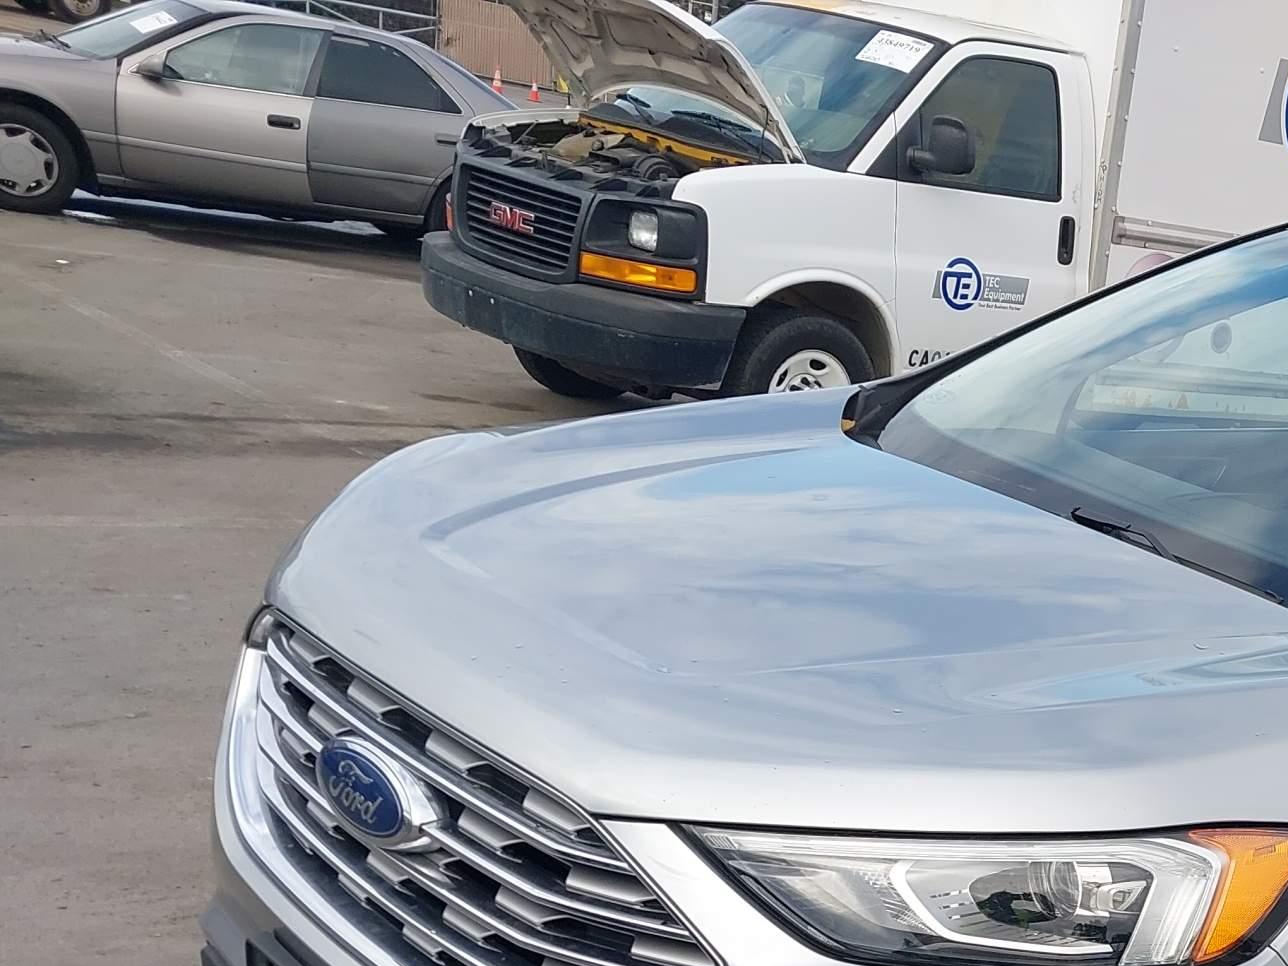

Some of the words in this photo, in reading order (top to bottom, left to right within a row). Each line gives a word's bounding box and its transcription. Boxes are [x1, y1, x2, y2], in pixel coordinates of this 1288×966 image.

[490, 201, 535, 234] GMC
[985, 276, 1001, 288] TEC
[983, 287, 1025, 303] Equipment
[329, 760, 384, 824] Ford
